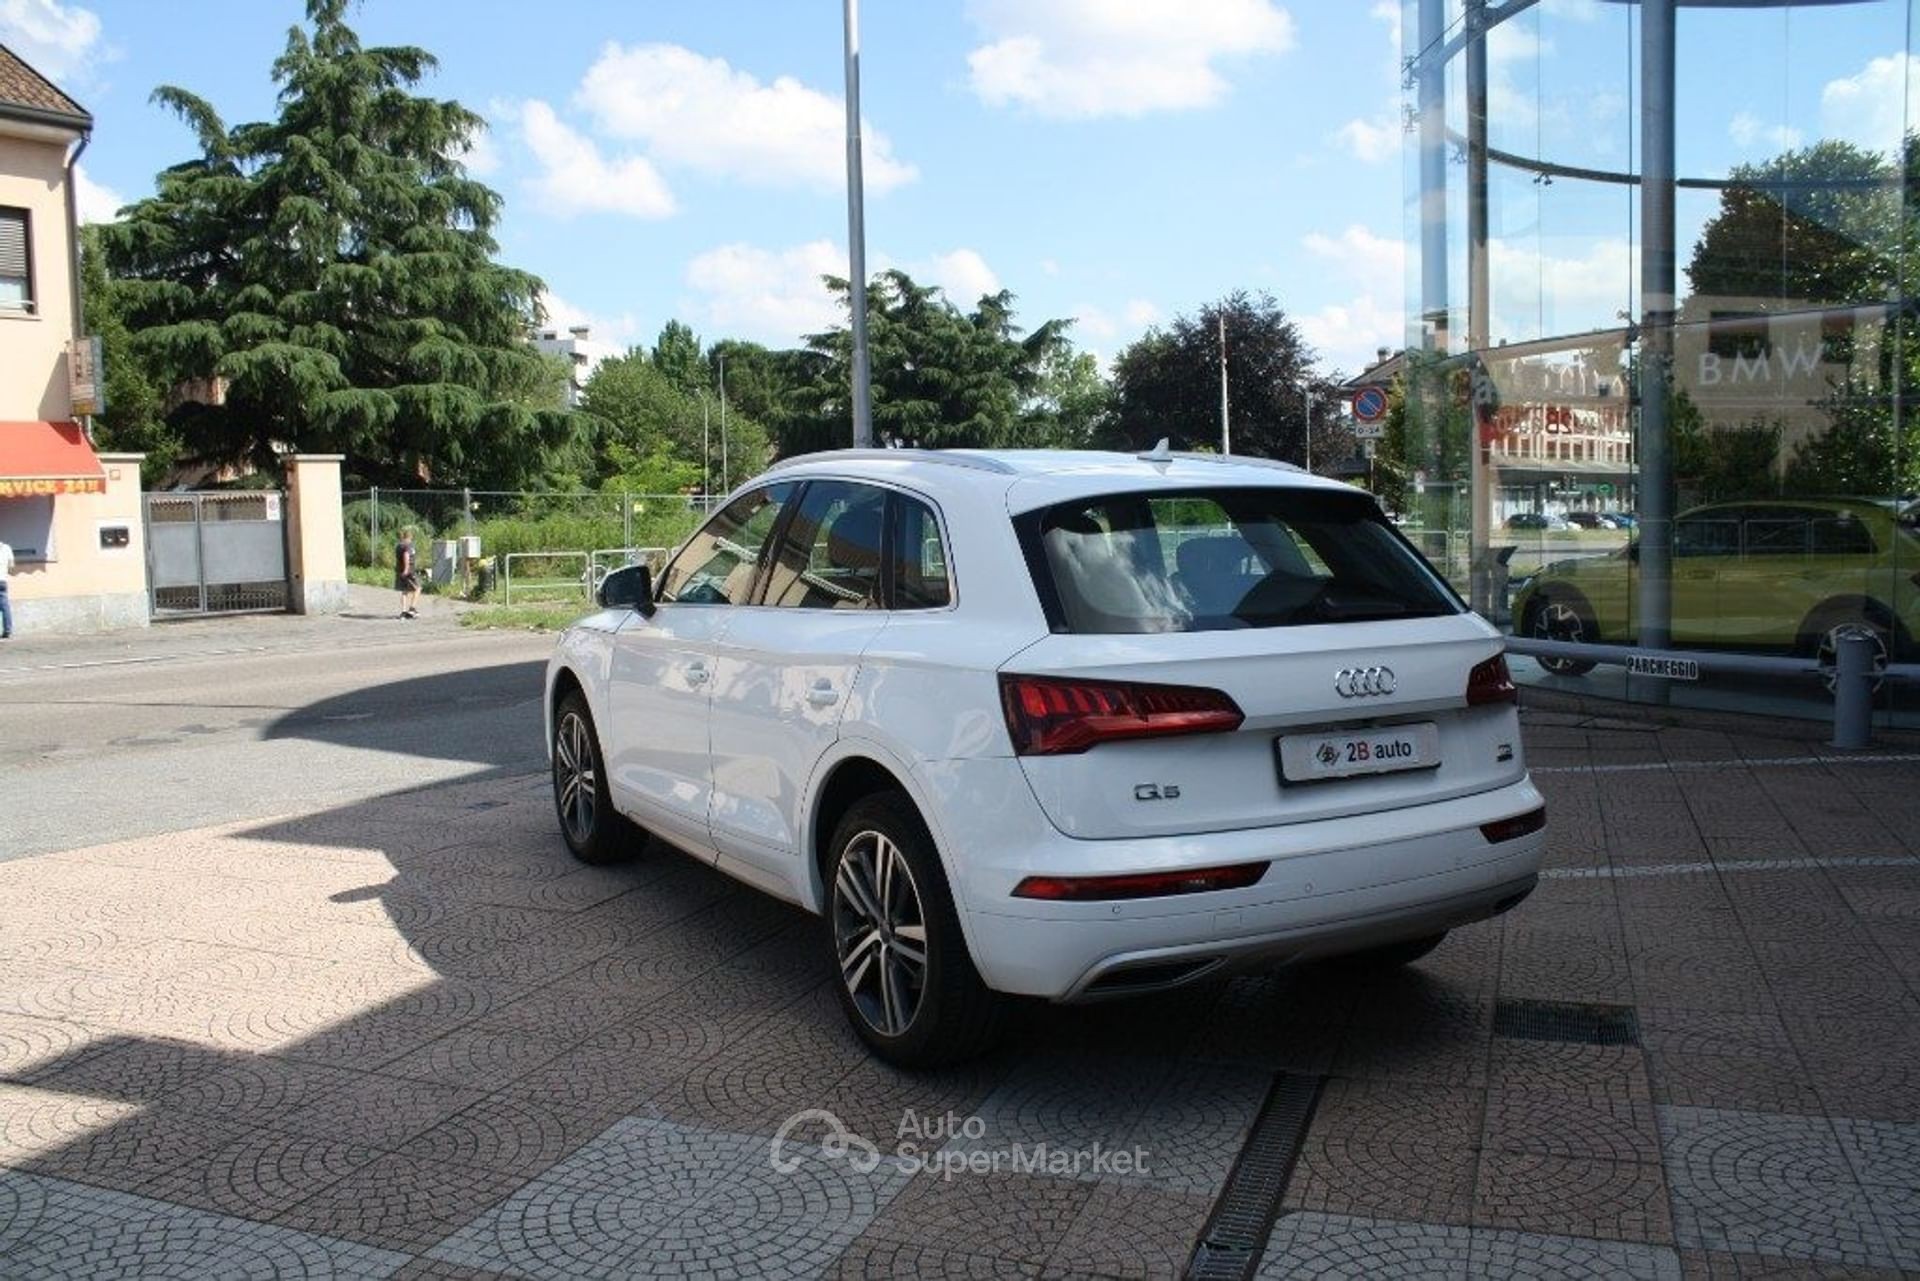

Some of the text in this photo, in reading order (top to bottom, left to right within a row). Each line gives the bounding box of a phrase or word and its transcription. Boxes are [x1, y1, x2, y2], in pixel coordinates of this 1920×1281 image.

[1698, 343, 1825, 386] BMW
[1626, 655, 1697, 678] PARCHEGGIO
[1346, 741, 1370, 762] 2B
[1375, 740, 1412, 759] auto
[1134, 783, 1181, 800] Q5
